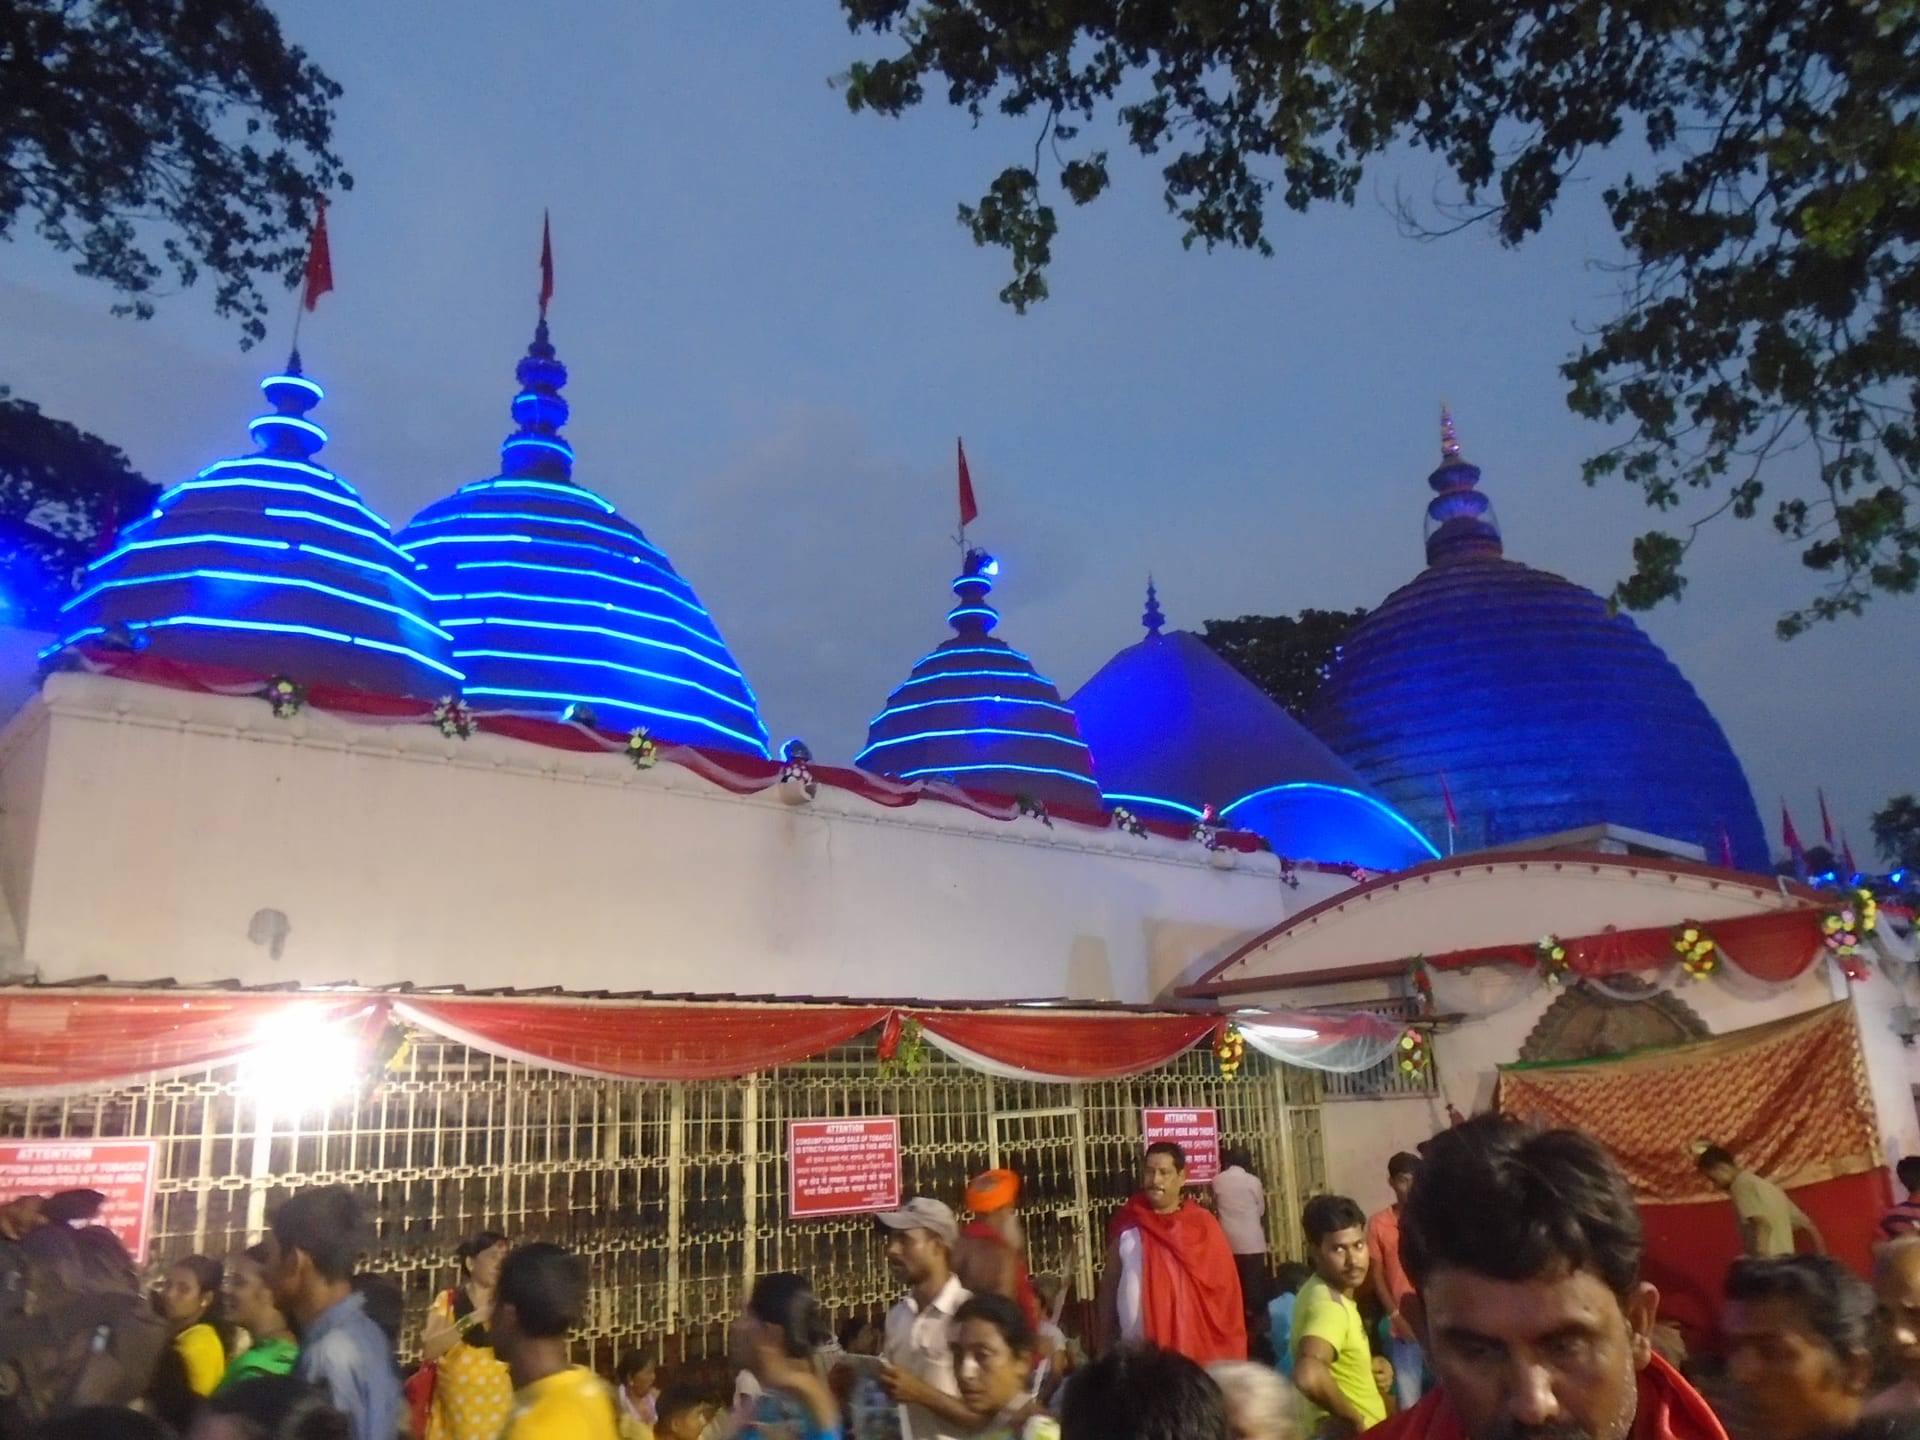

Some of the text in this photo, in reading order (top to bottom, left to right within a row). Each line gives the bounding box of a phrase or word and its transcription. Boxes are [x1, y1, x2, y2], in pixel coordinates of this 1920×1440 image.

[1164, 1113, 1198, 1123] ATTENTION
[826, 1124, 865, 1134] ATTENTION
[1163, 1128, 1175, 1137] SPIT
[1188, 1127, 1199, 1136] AND
[796, 1137, 833, 1146] CONSUMPTION
[846, 1135, 860, 1143] SALE
[869, 1134, 893, 1142] TOBACCO
[16, 1147, 94, 1160] ATTENTION
[802, 1146, 827, 1154] STRICTLY
[827, 1144, 859, 1152] PROHIBITED
[866, 1142, 877, 1150] THIS
[31, 1164, 54, 1174] AND
[55, 1163, 81, 1174] SALE
[82, 1162, 98, 1173] OF
[99, 1161, 147, 1173] TOBACCO
[15, 1174, 78, 1187] PROHIBITED
[79, 1174, 90, 1185] IN
[91, 1173, 115, 1184] THIS
